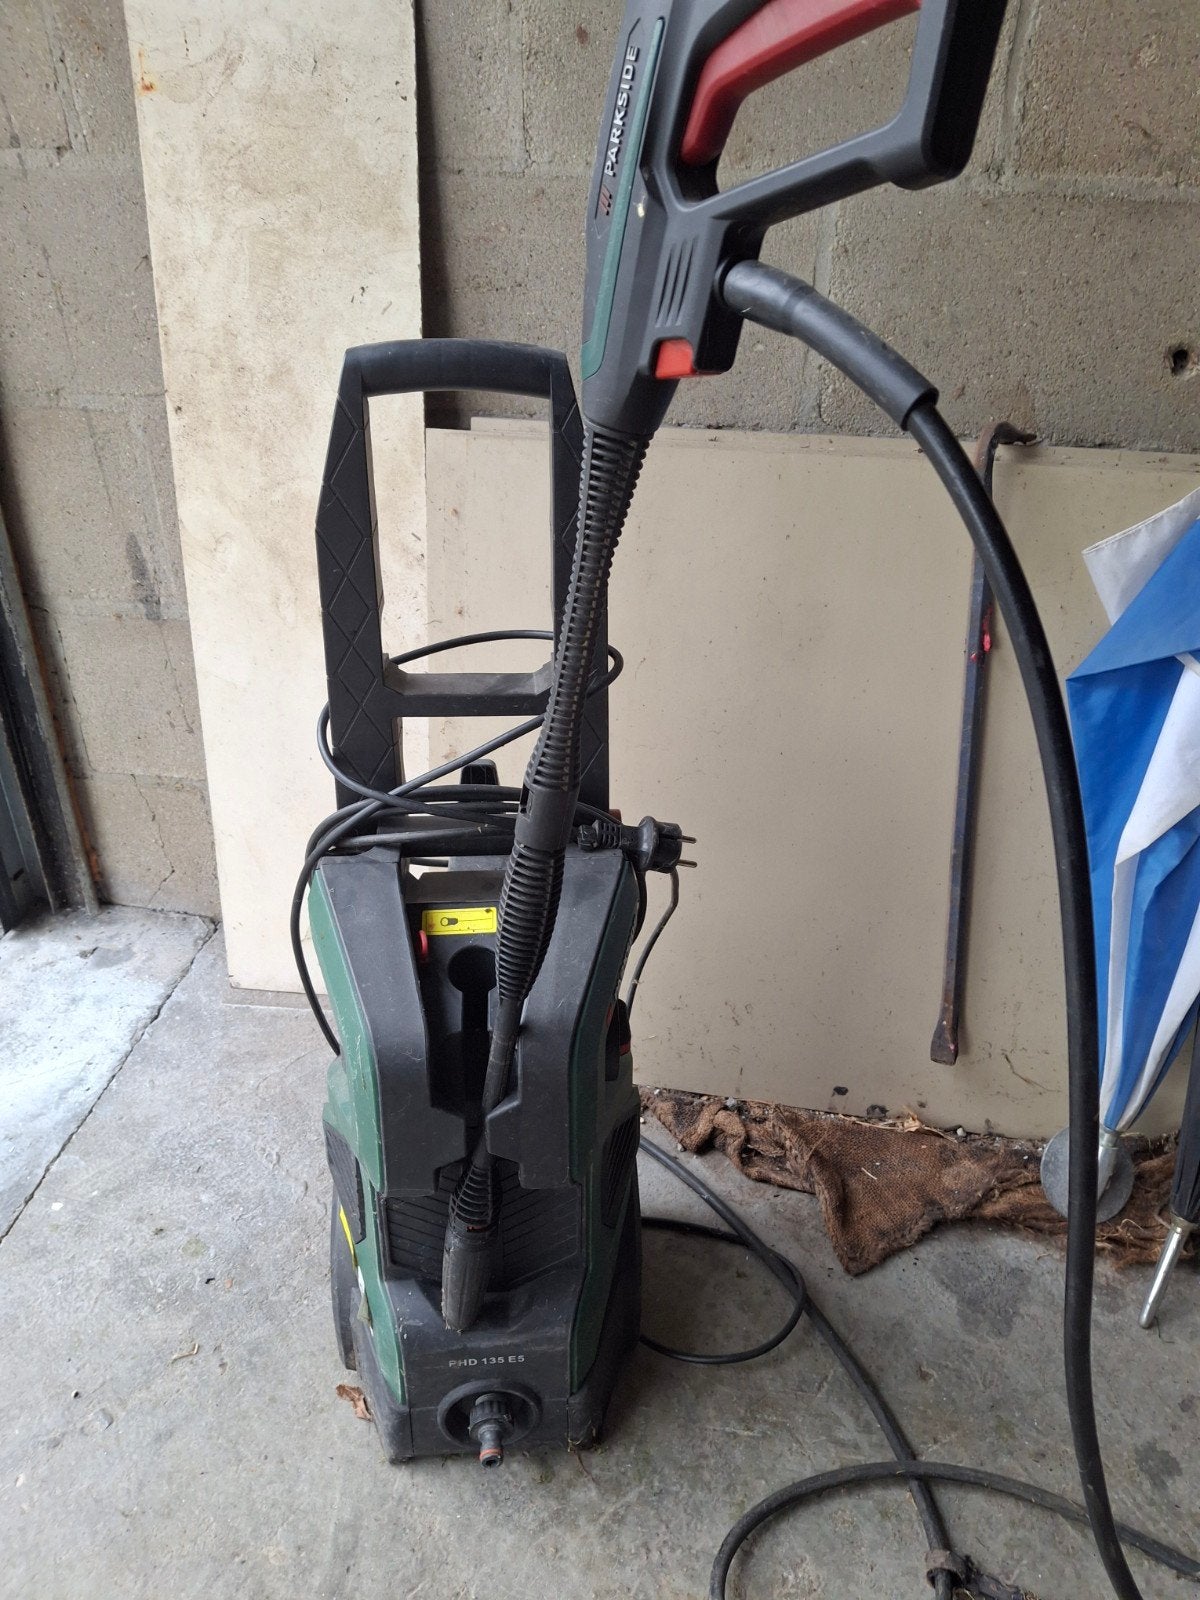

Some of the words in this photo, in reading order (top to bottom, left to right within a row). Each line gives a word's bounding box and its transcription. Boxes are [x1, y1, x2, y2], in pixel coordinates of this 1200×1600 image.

[604, 46, 639, 176] PARKSIDE
[448, 1358, 478, 1367] PHD
[481, 1356, 505, 1365] 135
[507, 1354, 525, 1363] E5
